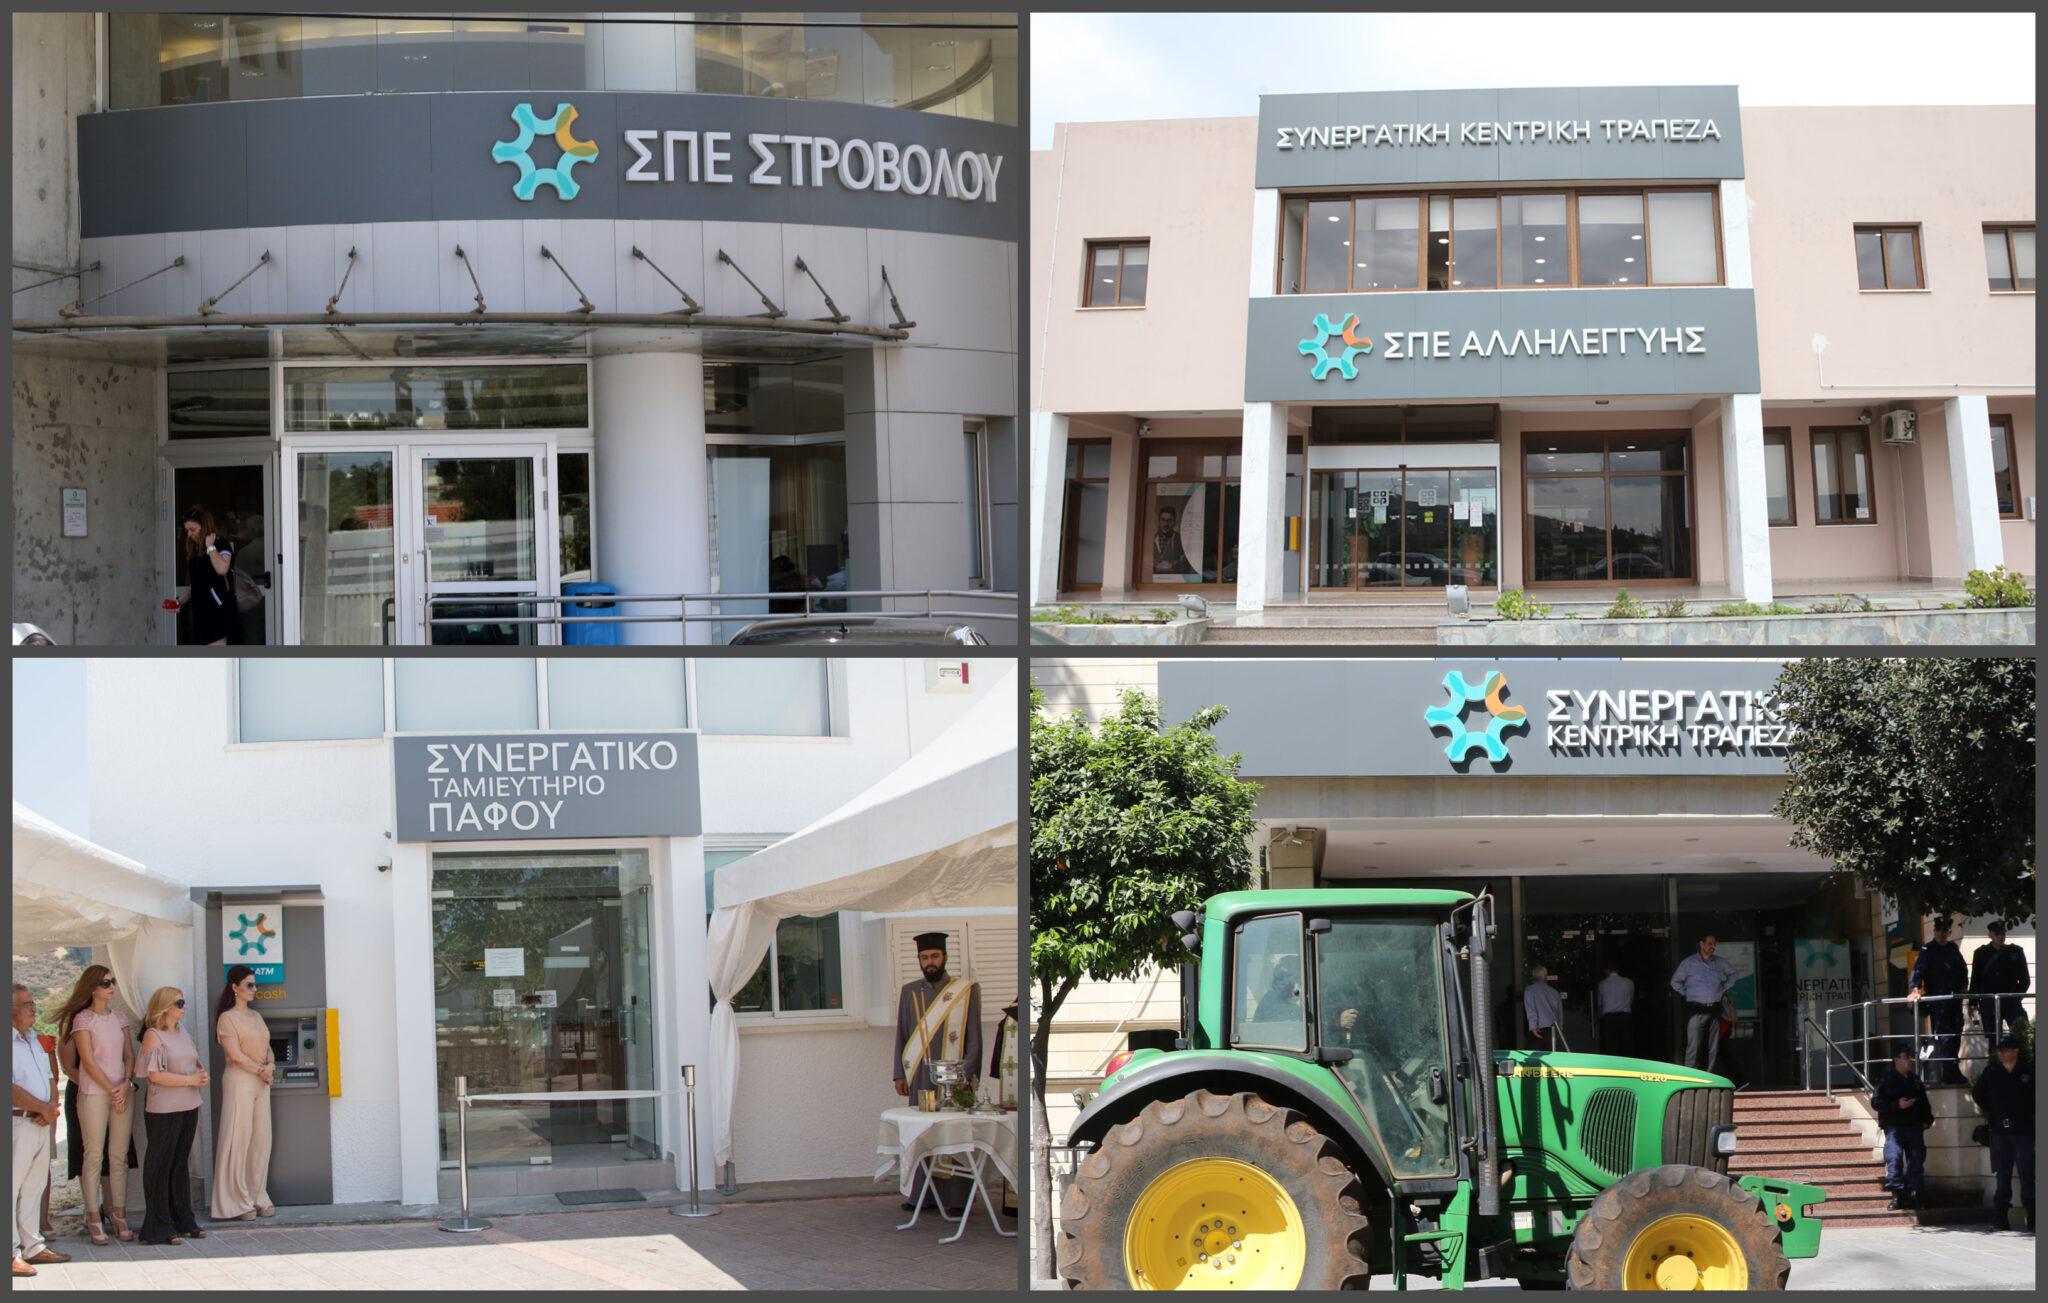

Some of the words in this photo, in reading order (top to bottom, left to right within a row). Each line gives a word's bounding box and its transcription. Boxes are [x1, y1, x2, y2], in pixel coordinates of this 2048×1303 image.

[1276, 122, 1450, 151] ΣΥΝΕΡΓΑΤΙΚΗ
[1460, 119, 1591, 145] ΚΕΝΤΡΙΚΗ
[1600, 118, 1721, 143] ΤΡΑΠΕΖΑ
[625, 130, 733, 183] ΣΠΕ
[748, 133, 1003, 203] ΣΤΡΟΒΟΛΟΥ
[1383, 331, 1451, 360] ΣΠΕ
[1460, 326, 1707, 359] ΑΛΛΗΛΕΓΓΥΗΣ
[1546, 689, 1800, 722] ΣΥΝΕΡΓΑΤΙΚ
[1546, 725, 1678, 747] ΚΕΝΤΡΙΚΗ
[427, 740, 678, 774] ΣΥΝΕΡΓΑΤΙΚΟ
[428, 774, 605, 798] ΤΑΜΙΕΥΤΗΡΙΟ
[428, 800, 564, 832] ΠΑΦΟΥ
[255, 986, 288, 1000] cash
